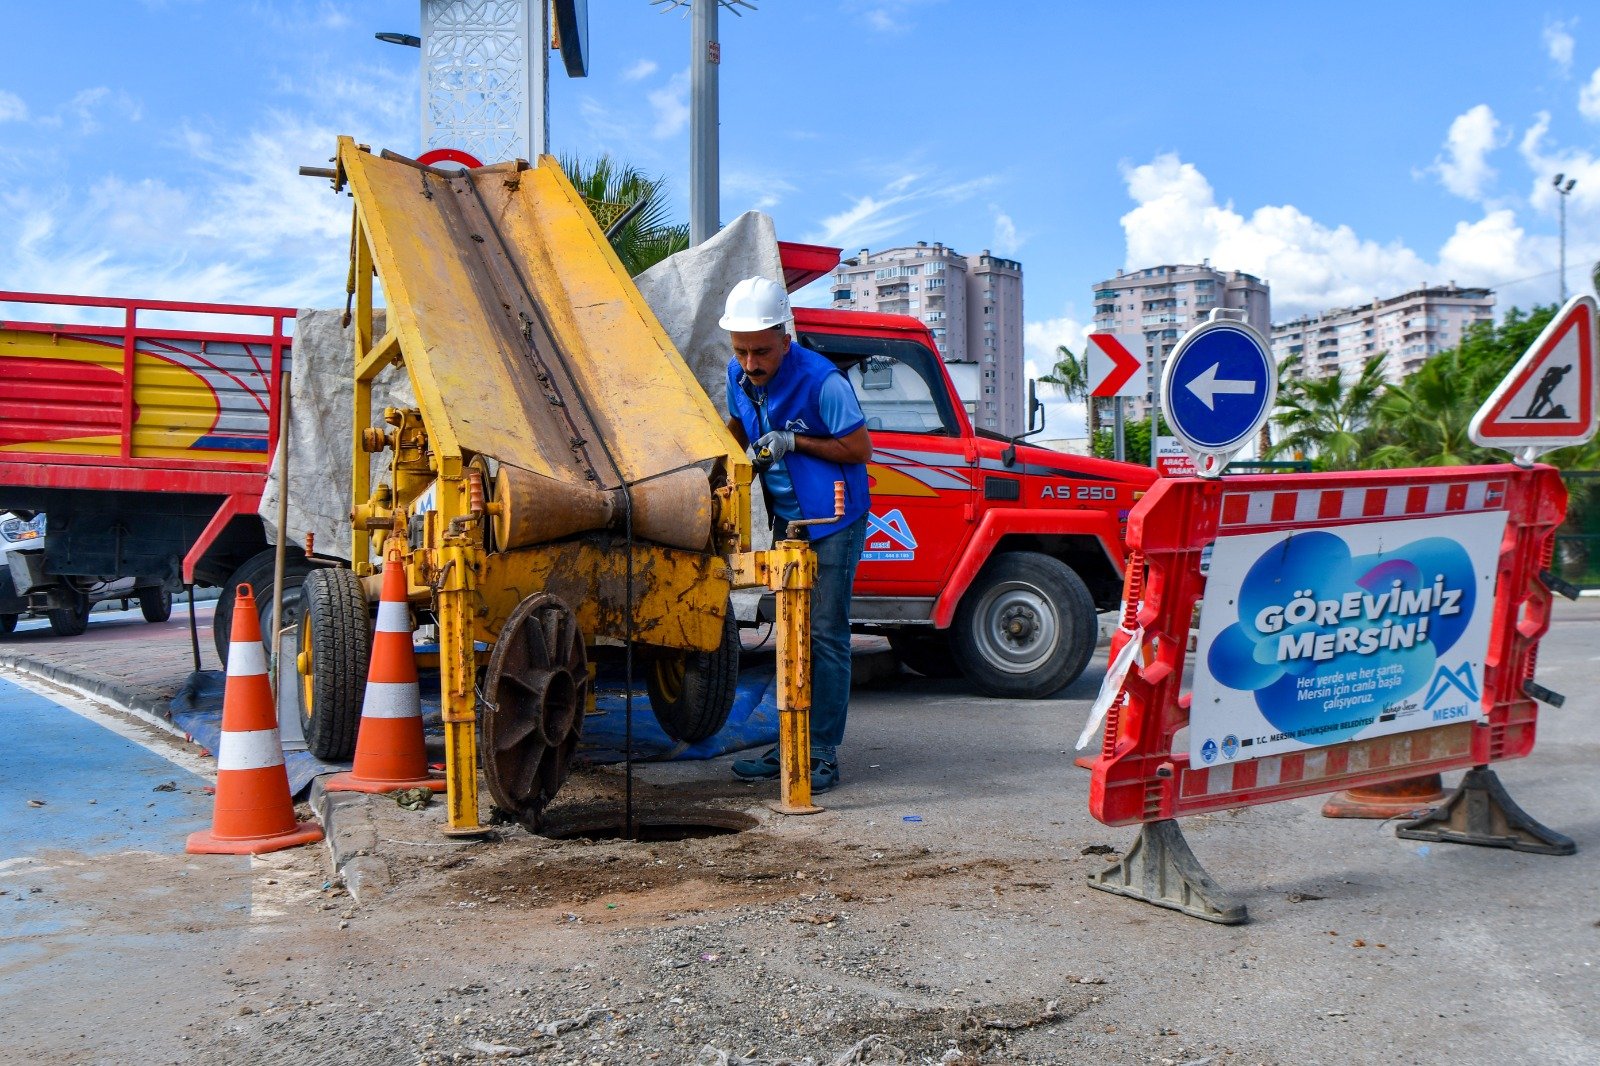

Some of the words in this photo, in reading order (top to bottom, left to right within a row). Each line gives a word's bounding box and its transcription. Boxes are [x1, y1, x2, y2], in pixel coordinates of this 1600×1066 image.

[1041, 485, 1071, 499] AS
[1076, 486, 1116, 500] 250
[1254, 574, 1463, 632] GÖREVİMİZ
[1276, 616, 1429, 661] MERSİN!
[1296, 677, 1315, 688] Her
[1316, 671, 1344, 688] yerde
[1346, 671, 1358, 681] ve
[1359, 667, 1376, 679] her
[1376, 663, 1405, 679] şartta,
[1297, 686, 1331, 701] Mersin
[1333, 684, 1350, 697] için
[1352, 679, 1376, 692] canla
[1378, 674, 1402, 689] başla
[1323, 693, 1375, 712] çalışıyoruz.
[1432, 702, 1469, 721] MESKİ
[1256, 737, 1268, 745] T.C.
[1340, 717, 1375, 730] BELEDİYESİ
